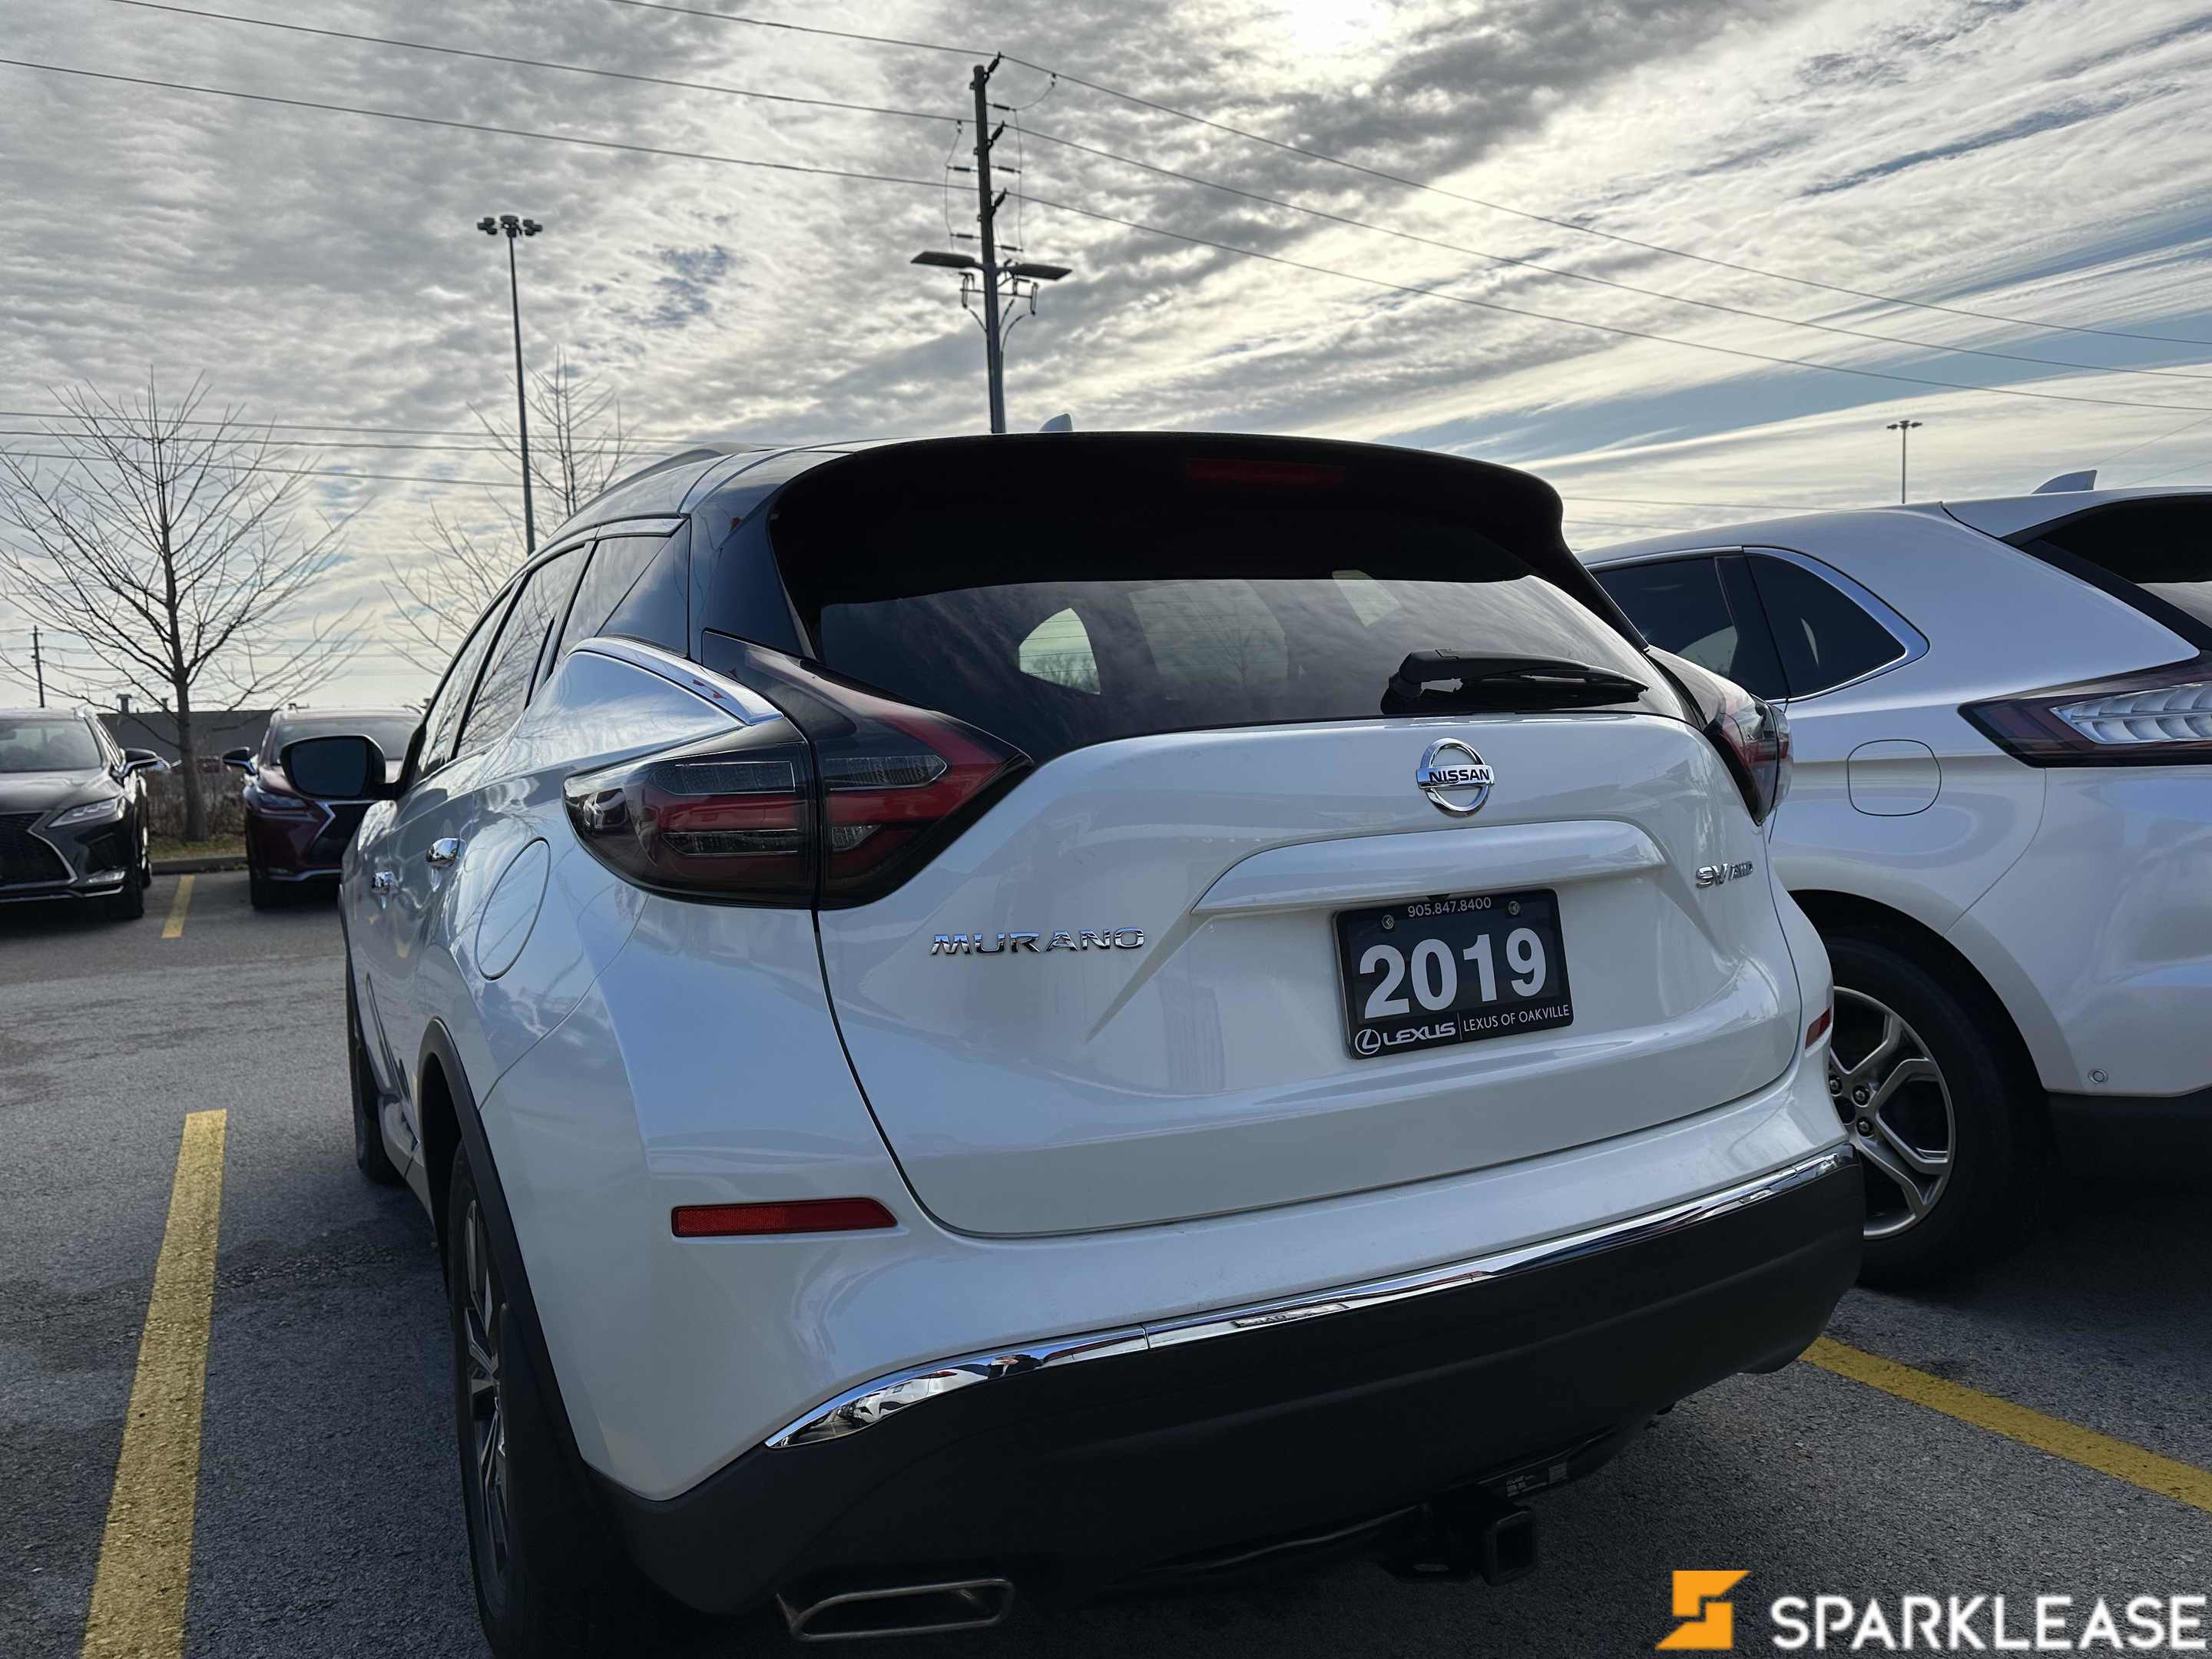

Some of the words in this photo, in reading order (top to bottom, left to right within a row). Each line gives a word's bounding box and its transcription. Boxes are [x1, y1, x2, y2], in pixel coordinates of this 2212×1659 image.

[1429, 769, 1491, 784] NISSAN
[1695, 863, 1729, 889] SV
[1408, 897, 1492, 917] 905.847.8400
[930, 926, 1146, 955] MURANO
[1359, 927, 1547, 1019] 2019
[1463, 1015, 1498, 1031] LEXUS
[1501, 1012, 1518, 1025] OF
[1518, 1004, 1570, 1022] OAKVILLE
[1383, 1022, 1456, 1046] LEXUS
